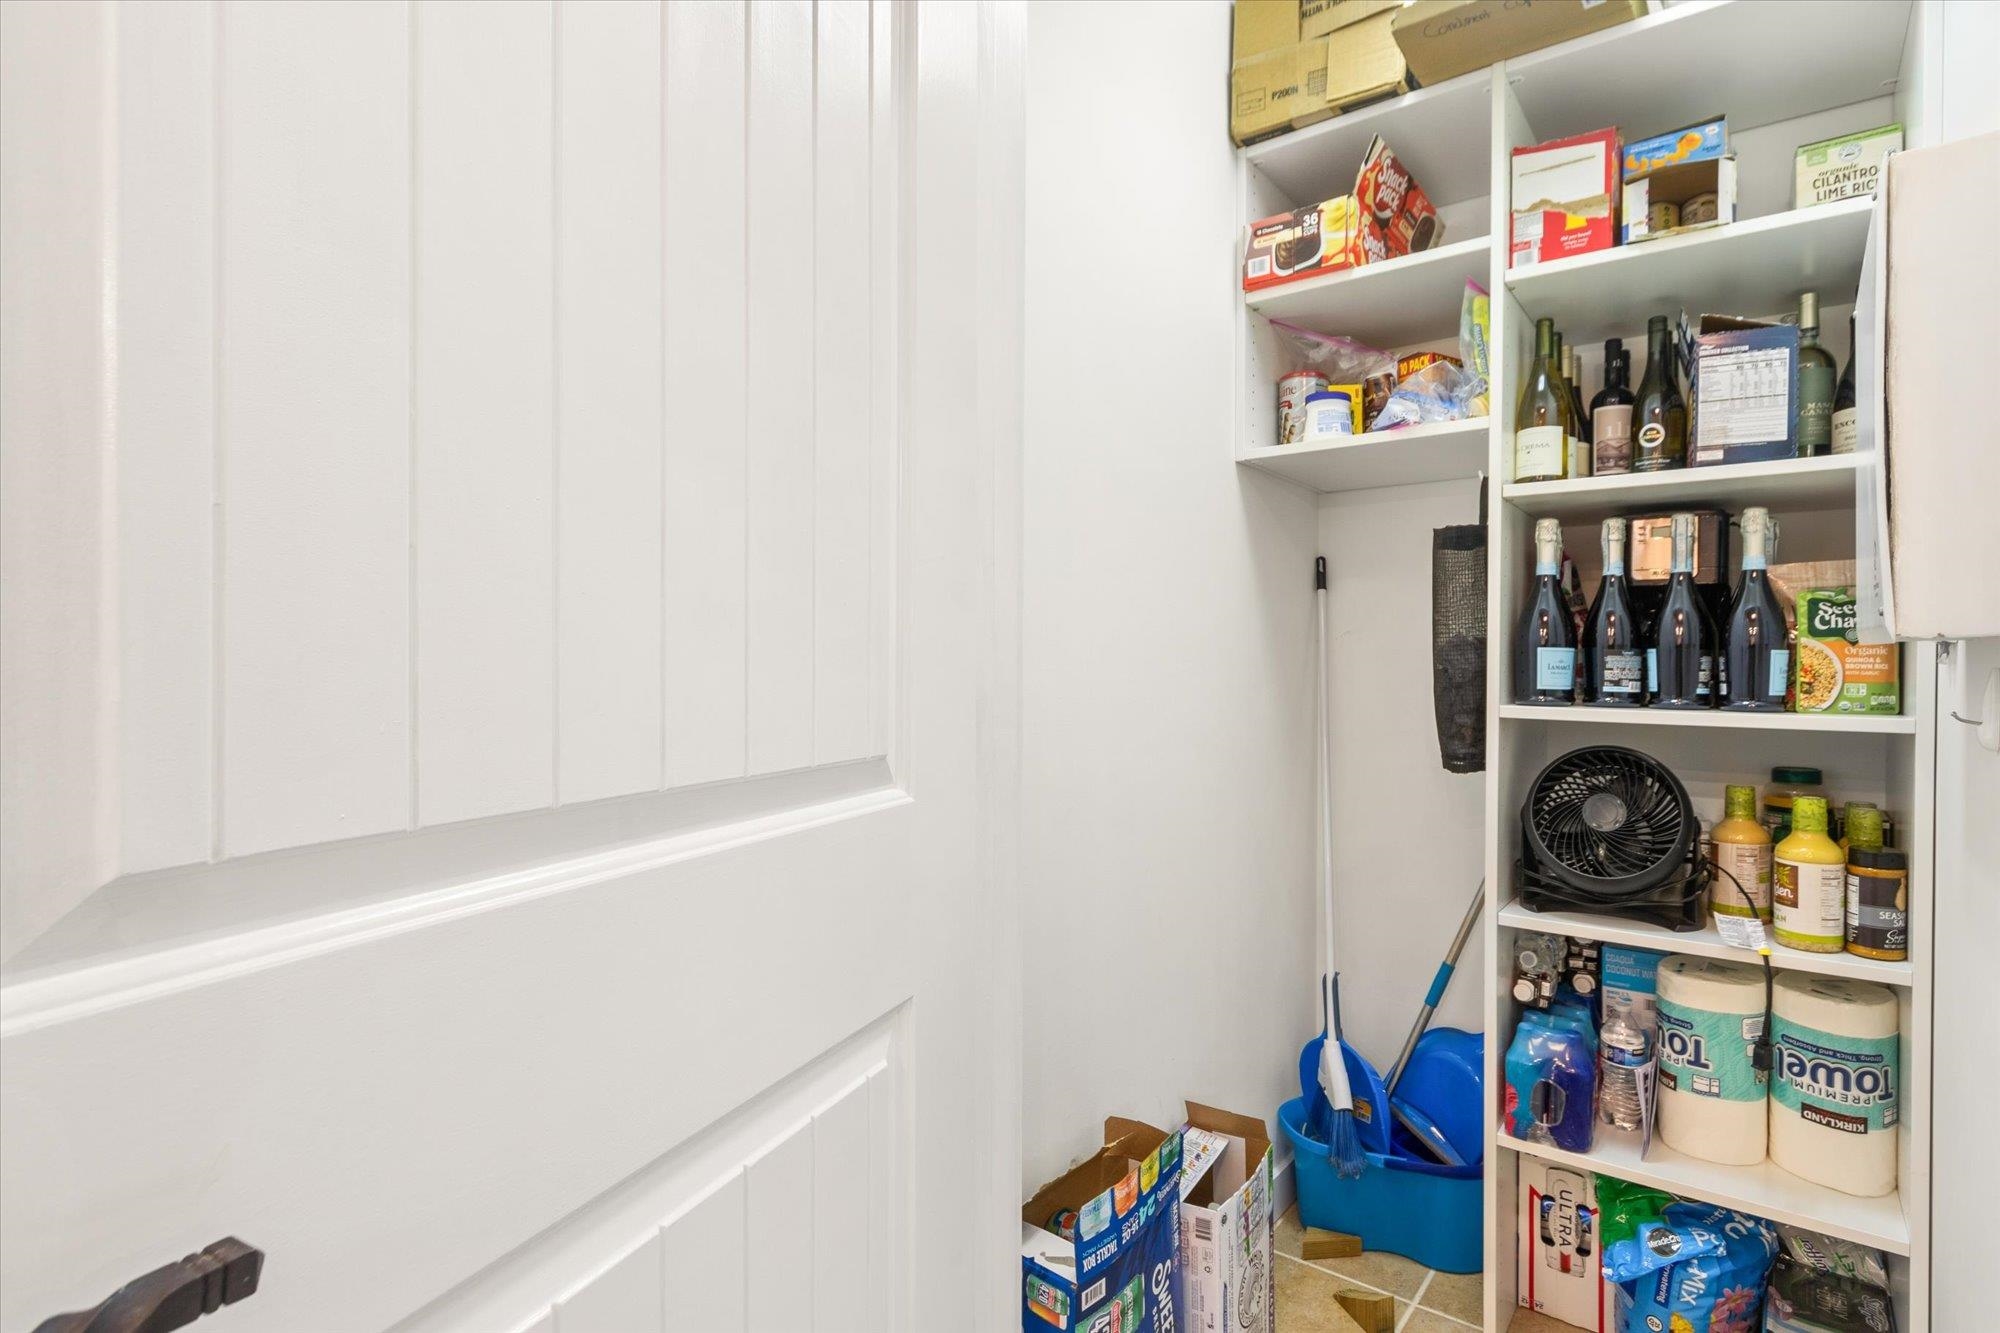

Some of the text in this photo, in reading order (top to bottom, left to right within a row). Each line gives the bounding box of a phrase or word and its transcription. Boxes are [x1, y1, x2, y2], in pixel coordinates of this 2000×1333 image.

[1378, 157, 1409, 195] Snack
[1812, 165, 1878, 189] CILANTRO
[1816, 185, 1848, 202] LIME
[1302, 212, 1319, 227] 36
[1409, 354, 1431, 371] PACK
[1844, 646, 1889, 657] Organic
[1845, 656, 1875, 664] QUINOA
[1605, 964, 1640, 977] COCONUT
[1818, 1048, 1834, 1056] and
[1835, 1052, 1857, 1062] Thick
[1792, 1080, 1872, 1106] PREMIUM
[1803, 1109, 1865, 1133] KIRKLAND
[1139, 1194, 1156, 1227] 24
[1558, 1189, 1573, 1247] ULTRA
[1082, 1241, 1118, 1273] TACKLE BOX
[1037, 1285, 1050, 1304] 420
